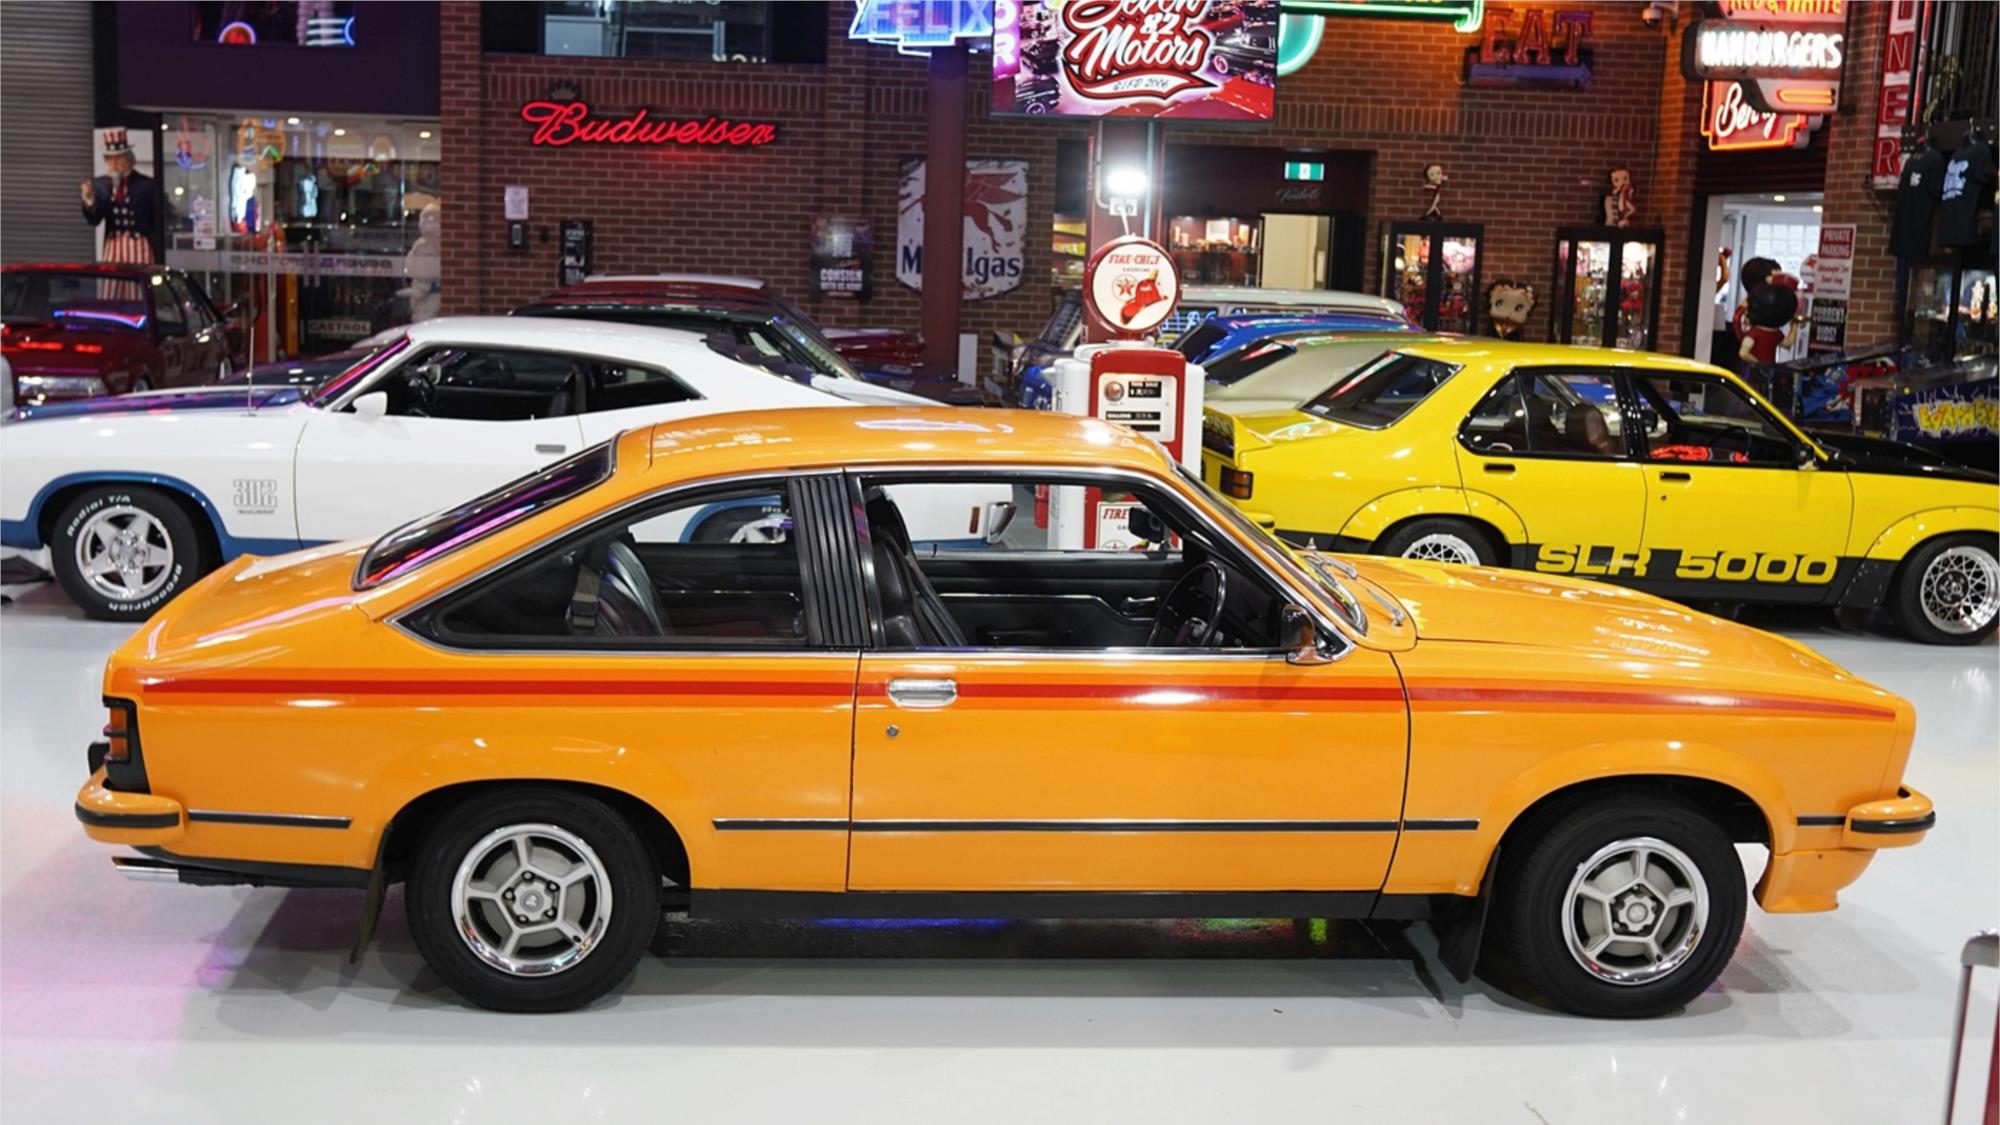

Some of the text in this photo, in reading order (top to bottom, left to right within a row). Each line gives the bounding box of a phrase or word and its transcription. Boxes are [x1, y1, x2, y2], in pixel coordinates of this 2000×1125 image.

[1140, 12, 1181, 35] 82
[1480, 8, 1593, 64] EAT
[1070, 24, 1204, 78] Motors
[1701, 31, 1843, 69] HAMBURGERS
[522, 102, 776, 145] Budweiser
[902, 246, 1021, 284] Mlgas
[308, 321, 368, 332] CASTROL
[233, 479, 277, 508] 302
[66, 494, 131, 537] Radial T/A
[1535, 543, 1838, 584] SLR 5000
[108, 563, 183, 612] BFGoodrich
